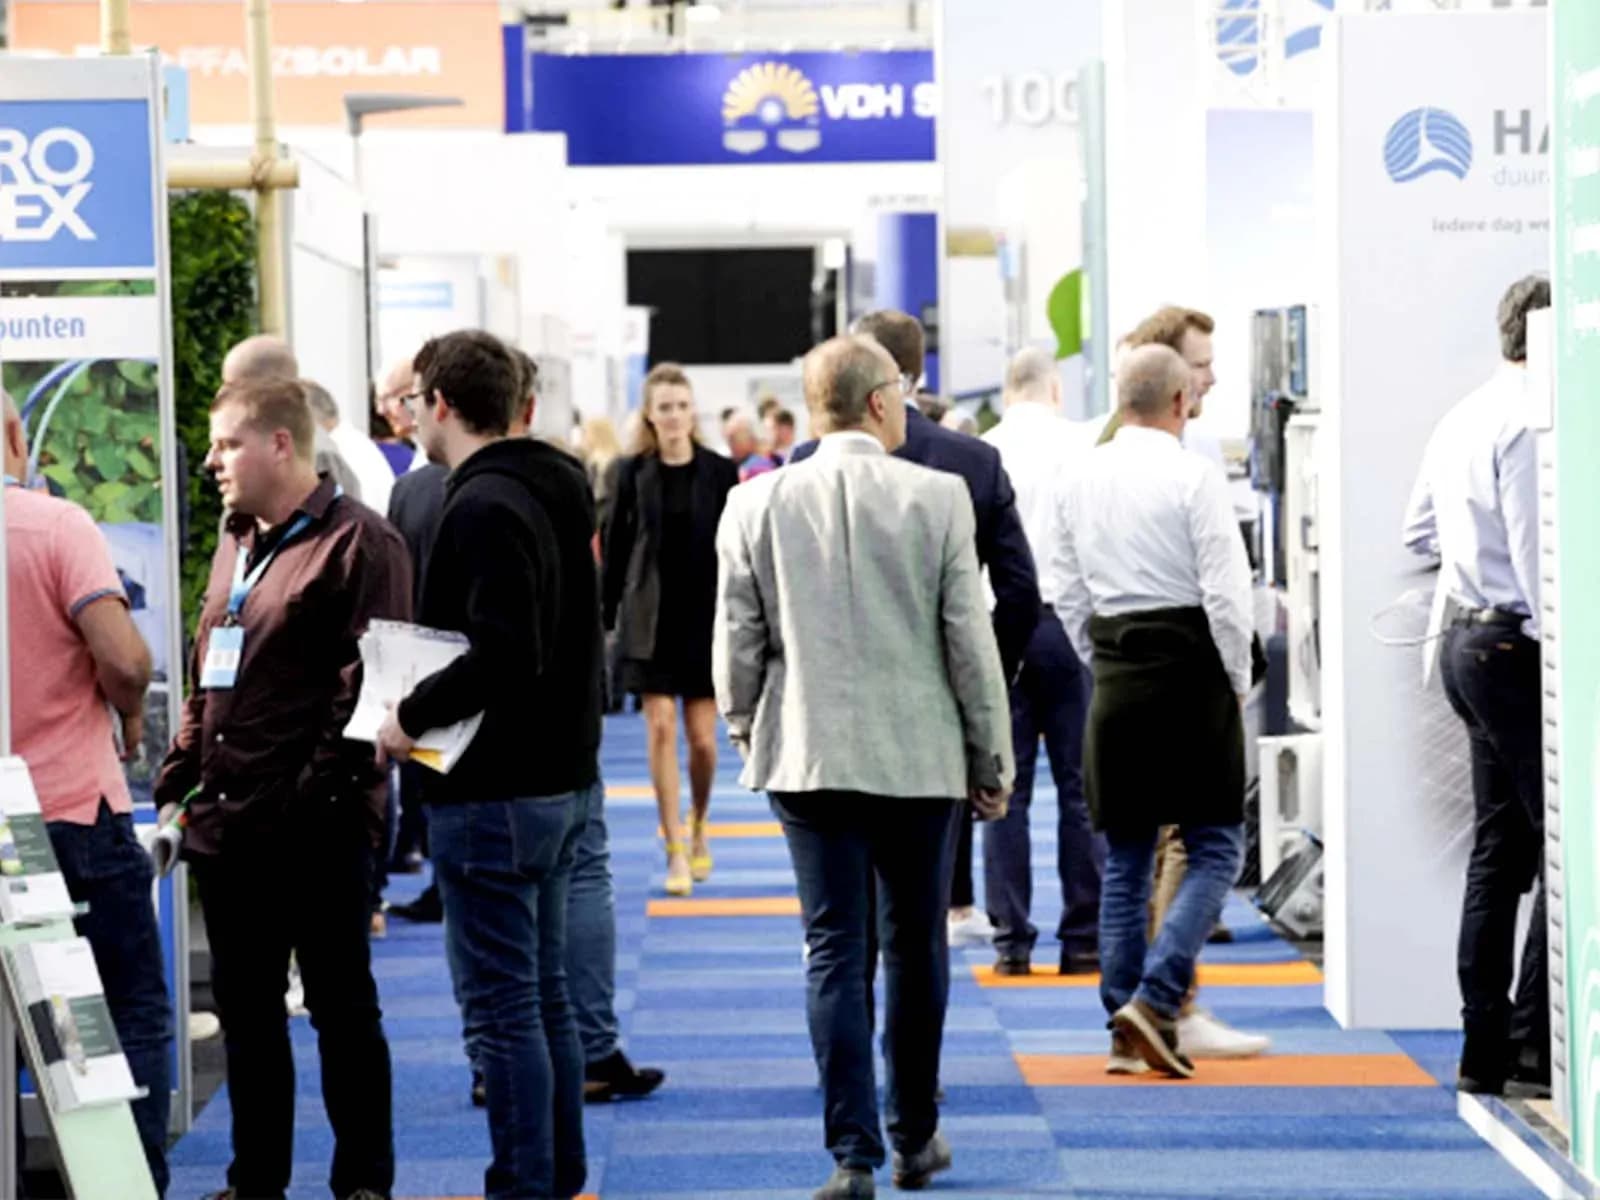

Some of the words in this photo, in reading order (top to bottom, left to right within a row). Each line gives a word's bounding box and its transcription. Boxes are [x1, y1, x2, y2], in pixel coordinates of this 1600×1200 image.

[178, 45, 441, 79] PFAZSOLAR
[819, 83, 904, 119] VDH
[1493, 108, 1549, 155] H
[1491, 217, 1522, 235] dag
